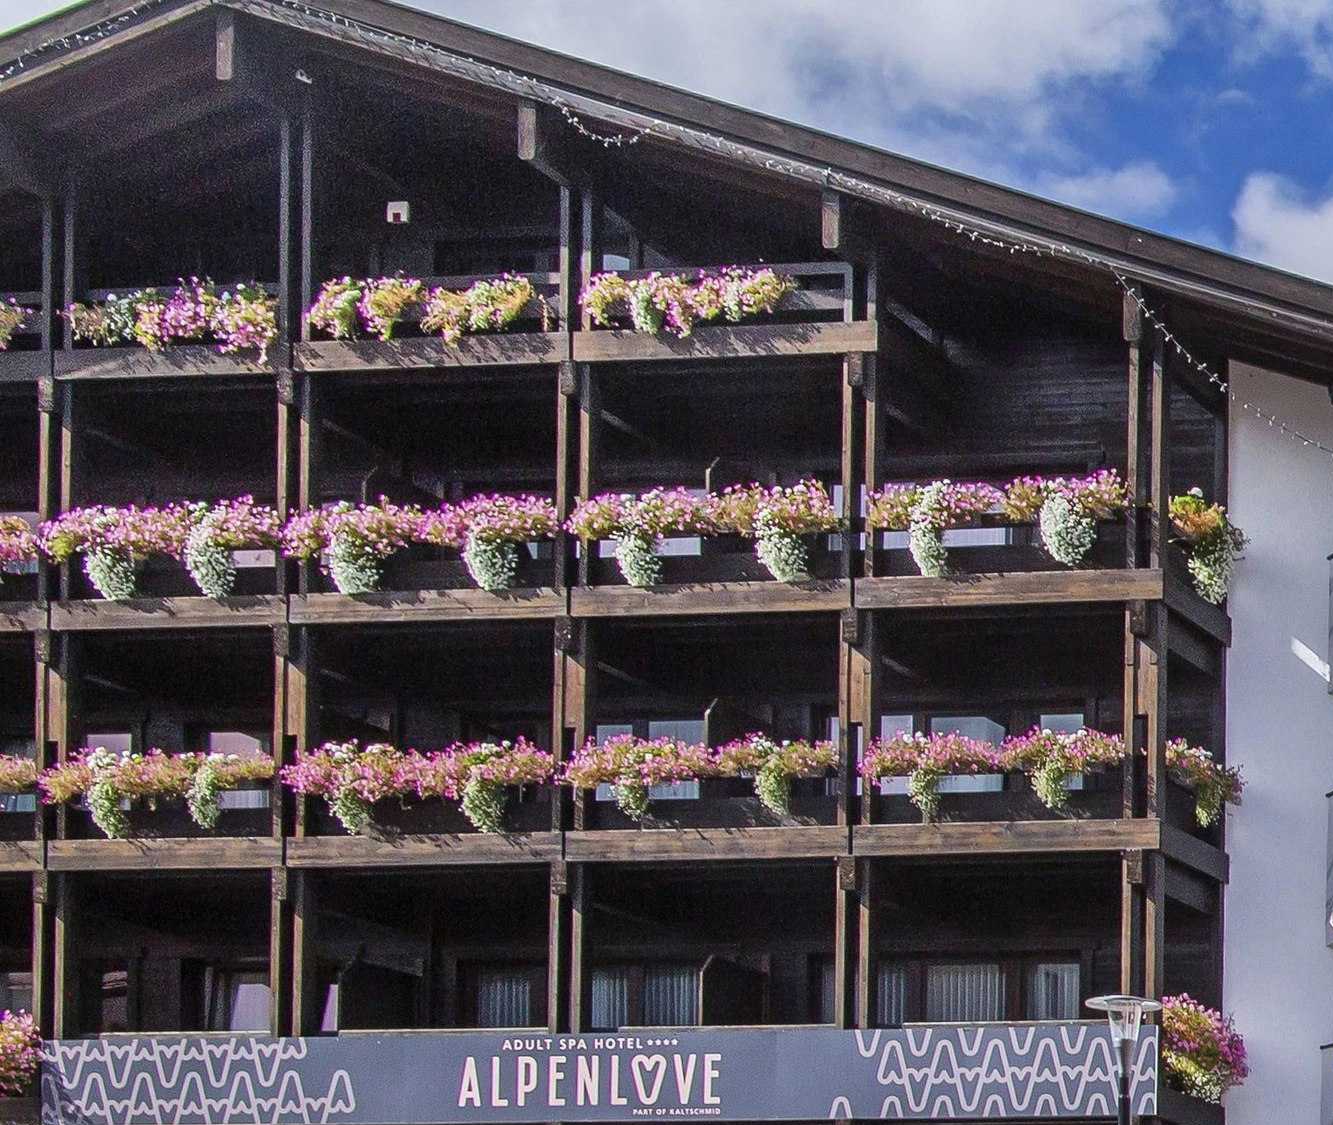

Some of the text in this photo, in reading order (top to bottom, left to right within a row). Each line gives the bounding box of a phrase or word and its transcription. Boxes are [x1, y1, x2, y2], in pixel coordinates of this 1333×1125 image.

[502, 1037, 643, 1051] ADULT SPA HOTEL
[458, 1053, 722, 1108] ALPENLOVE
[632, 1108, 721, 1116] PART OF KALTSCHMID
